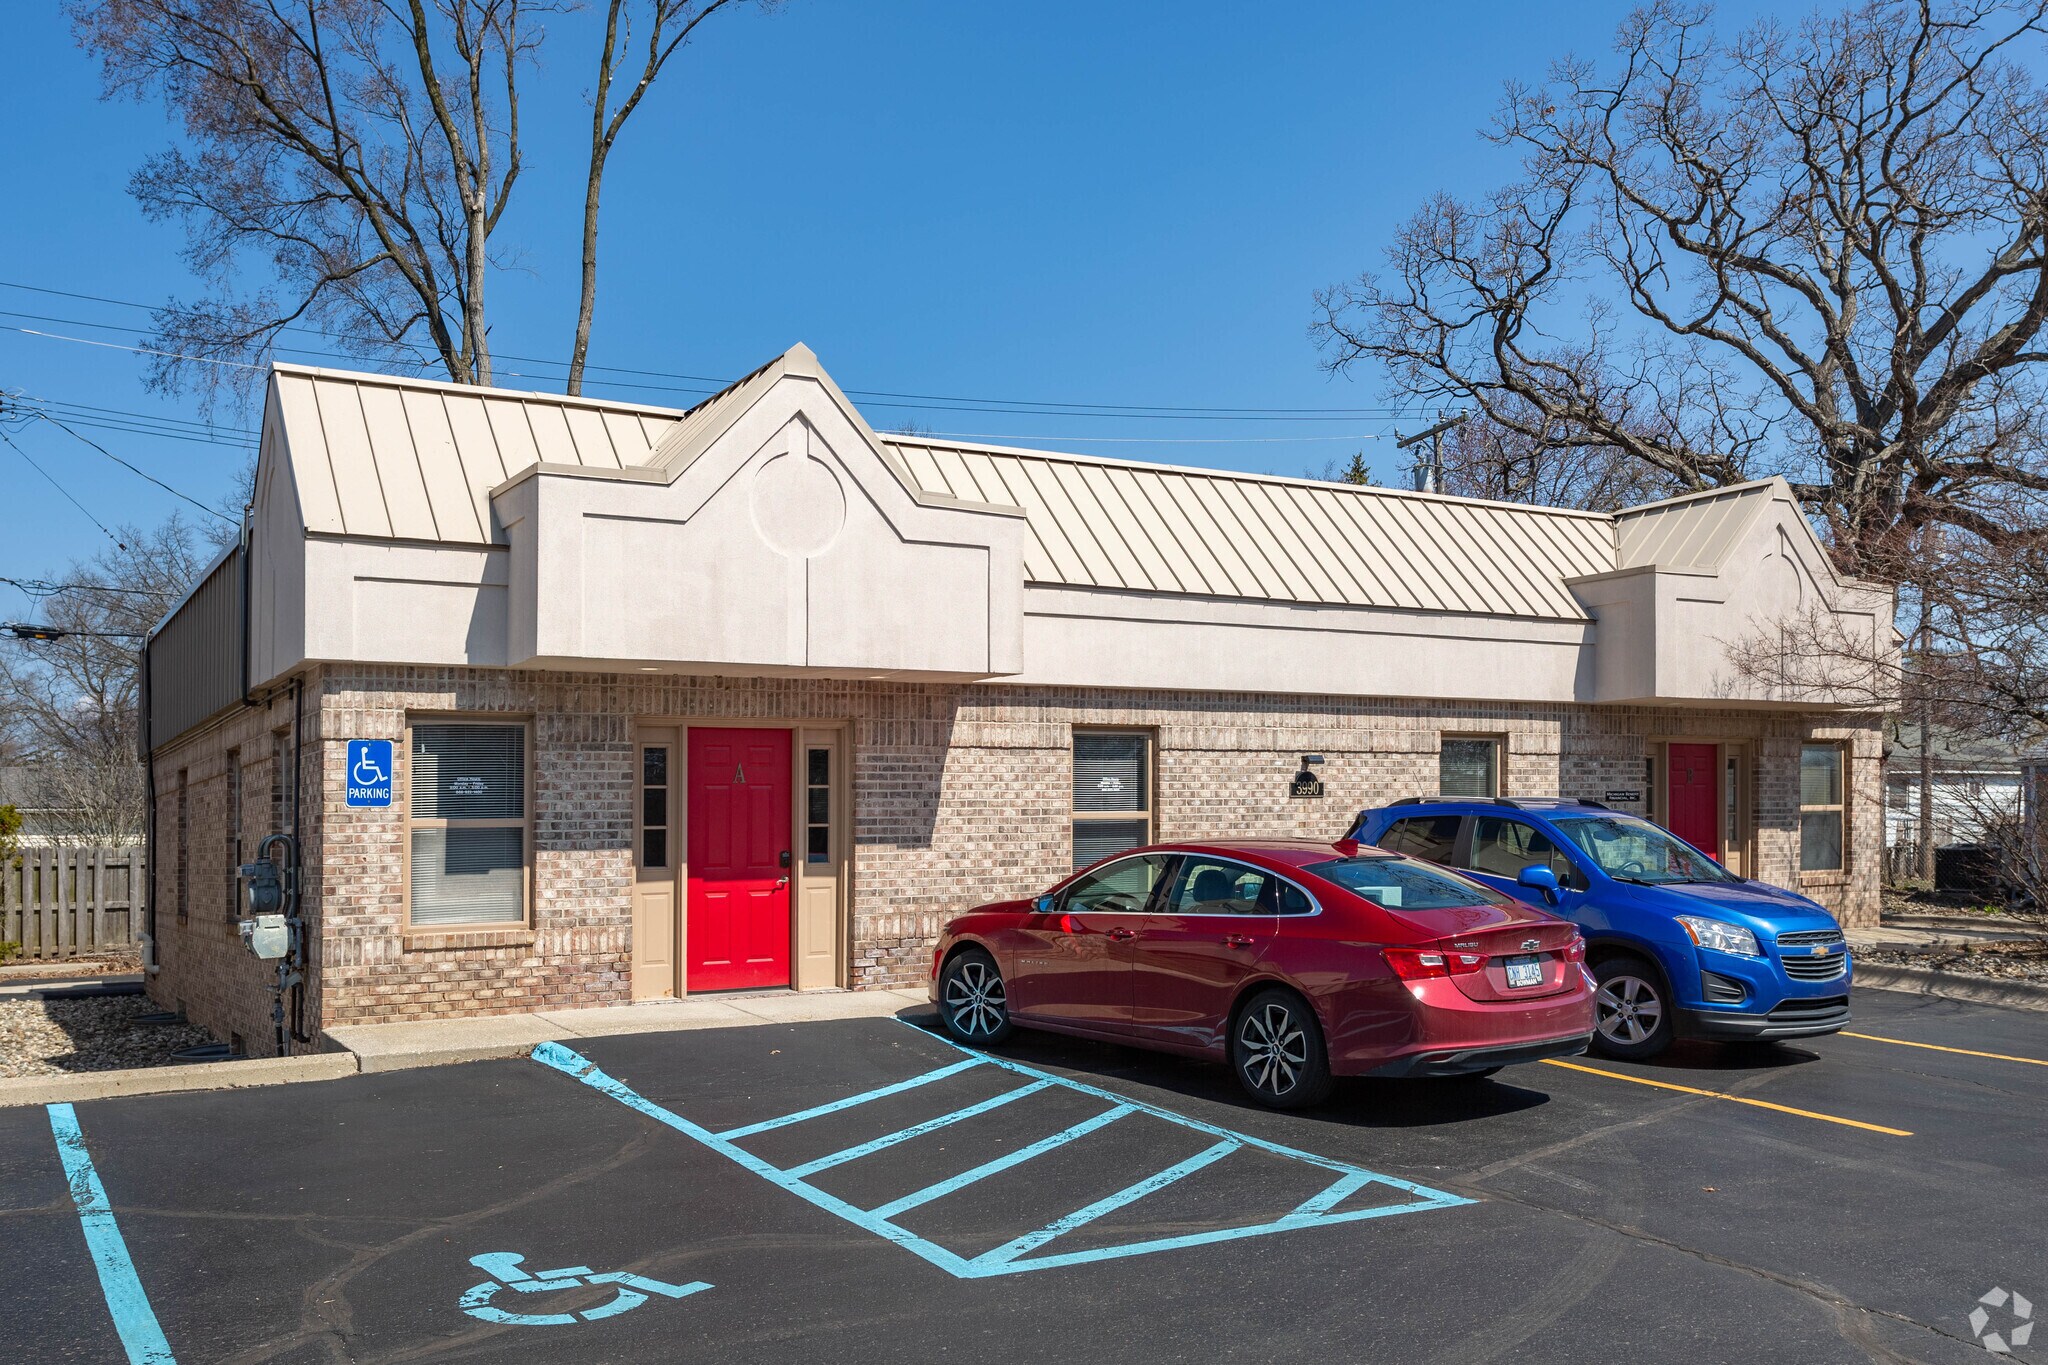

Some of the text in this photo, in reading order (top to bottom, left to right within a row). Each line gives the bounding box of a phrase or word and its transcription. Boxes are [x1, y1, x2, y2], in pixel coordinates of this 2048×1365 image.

[732, 760, 746, 784] A
[349, 787, 389, 799] PARKING
[1296, 781, 1319, 795] 3990
